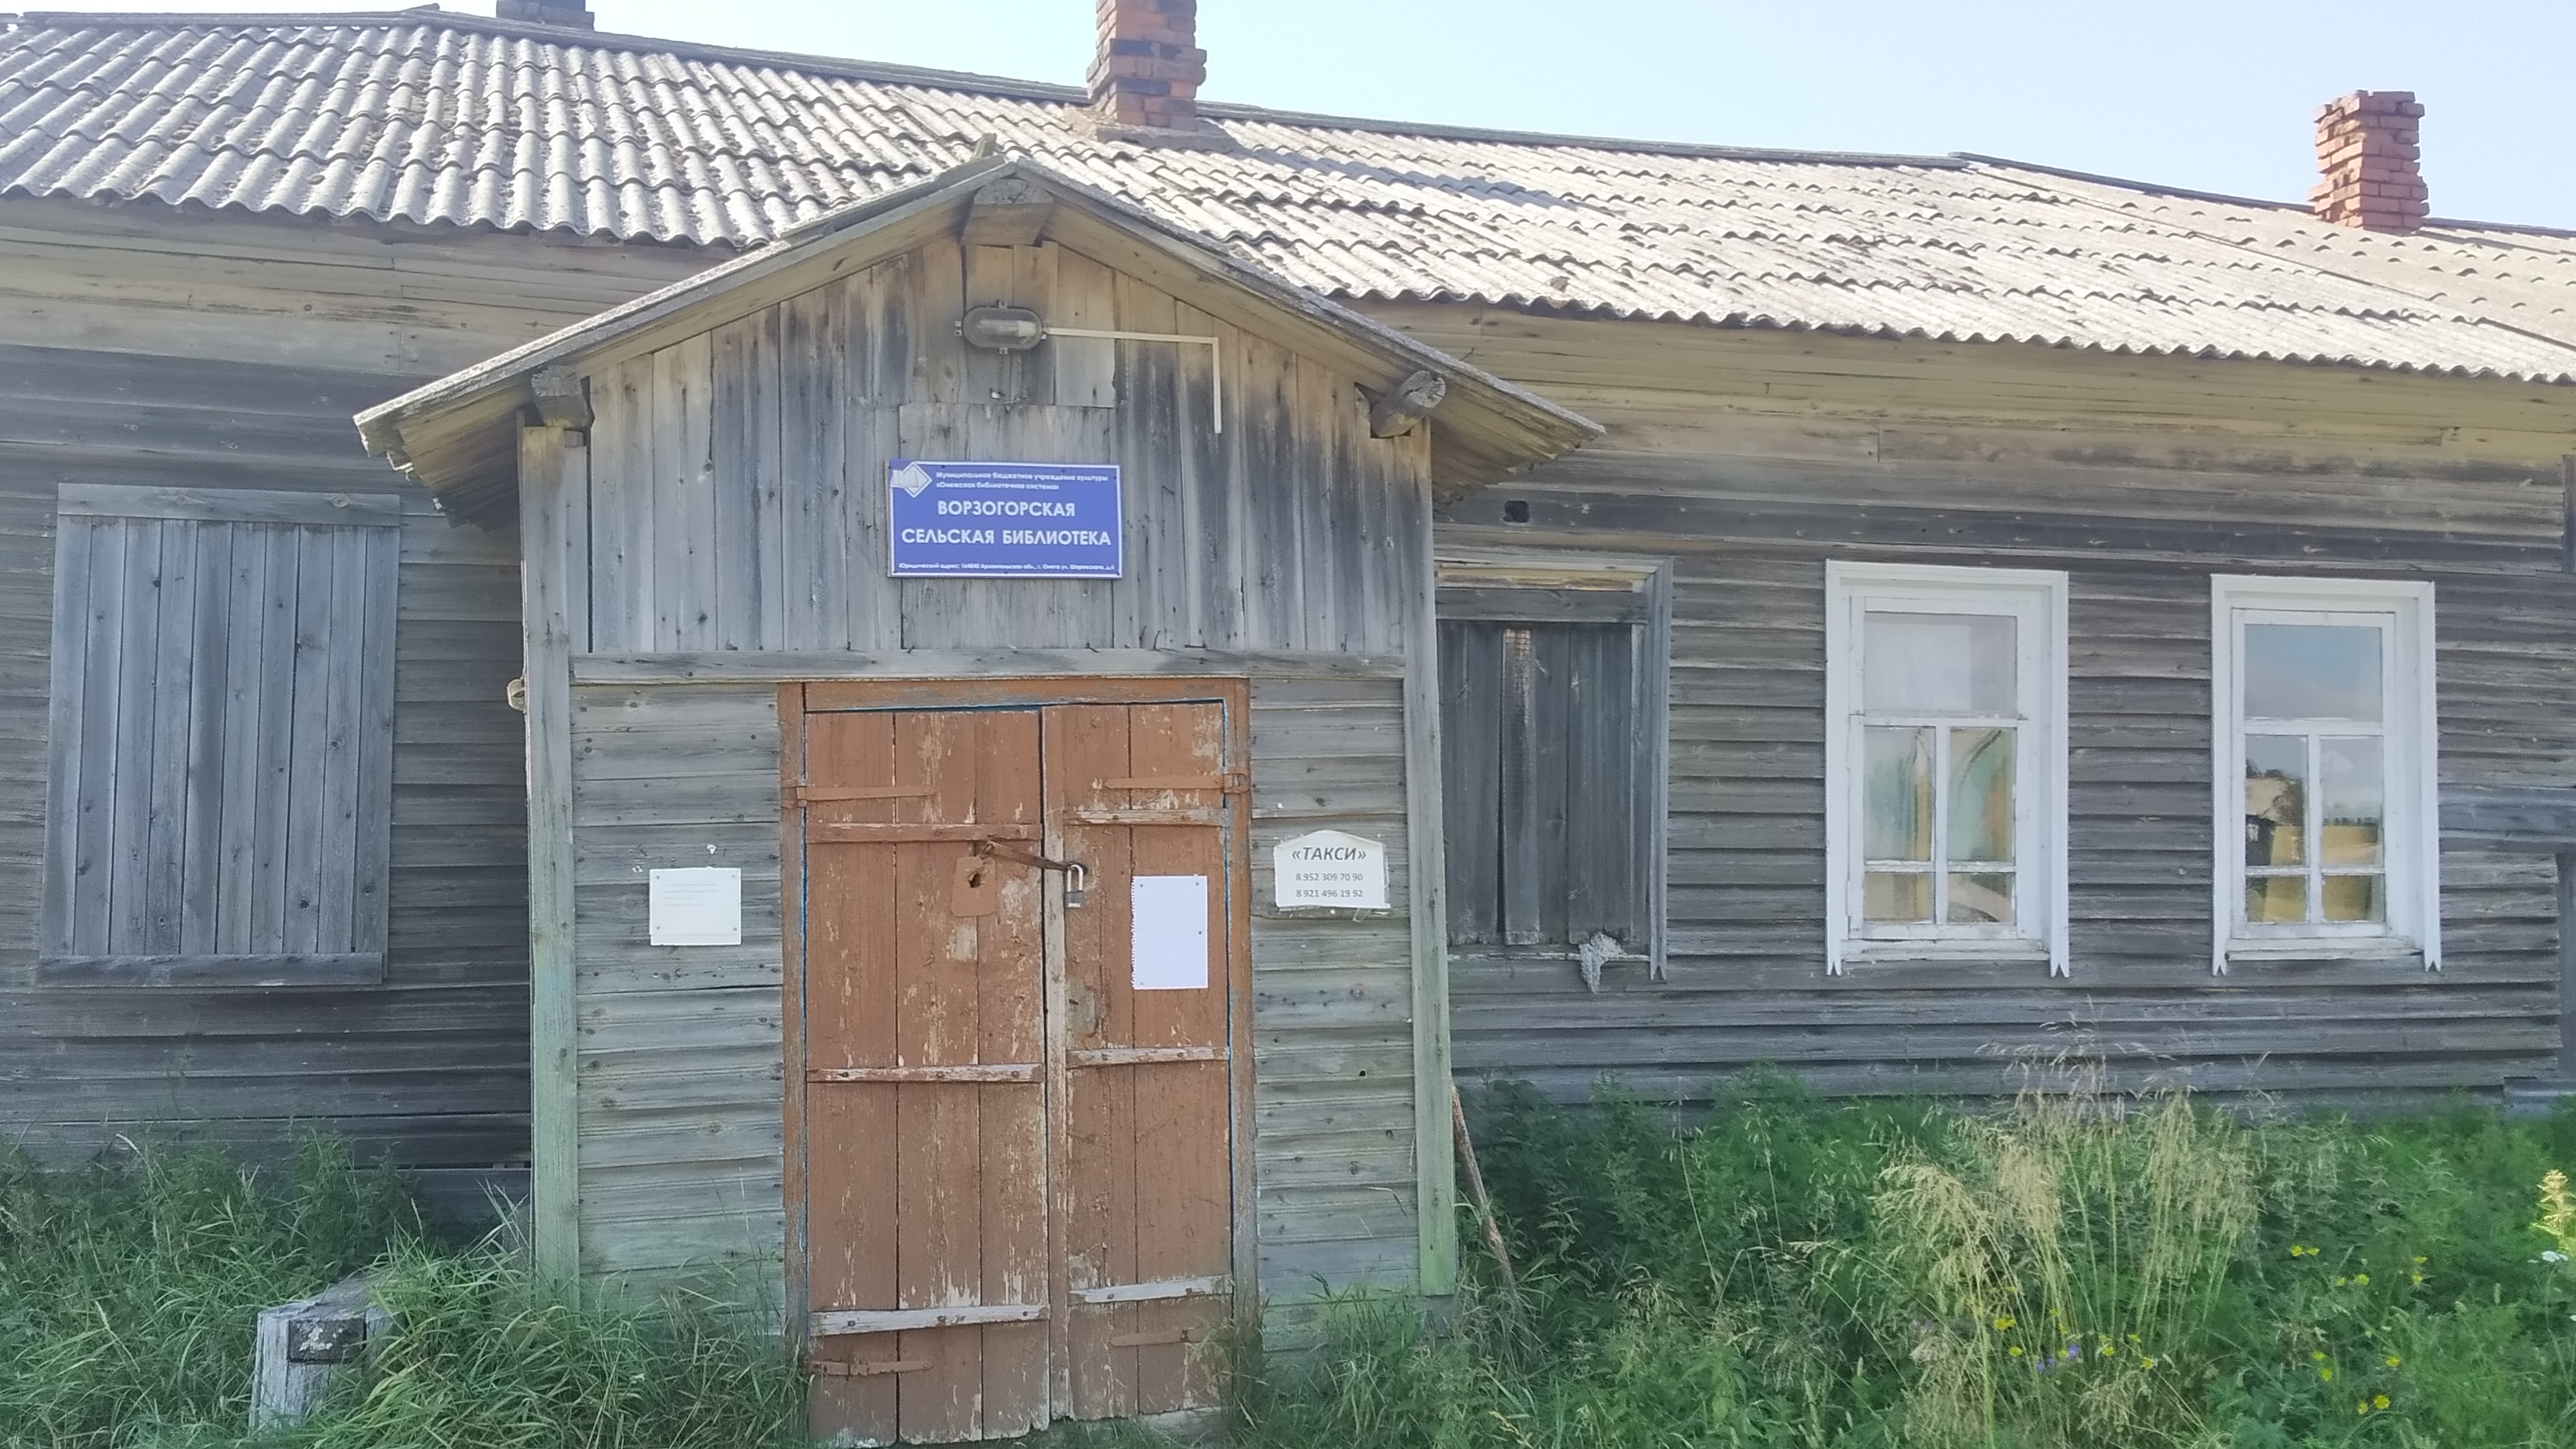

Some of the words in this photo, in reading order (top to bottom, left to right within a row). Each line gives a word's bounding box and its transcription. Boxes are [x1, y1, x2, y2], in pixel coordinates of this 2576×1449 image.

[938, 500, 1075, 516] ВОРЗОГОРСКАЯ
[902, 529, 994, 544] СЕЛЬСКАЯ
[1002, 529, 1112, 545] БИБЛИОТЕКА
[1292, 847, 1367, 860] «ТАКСИ»
